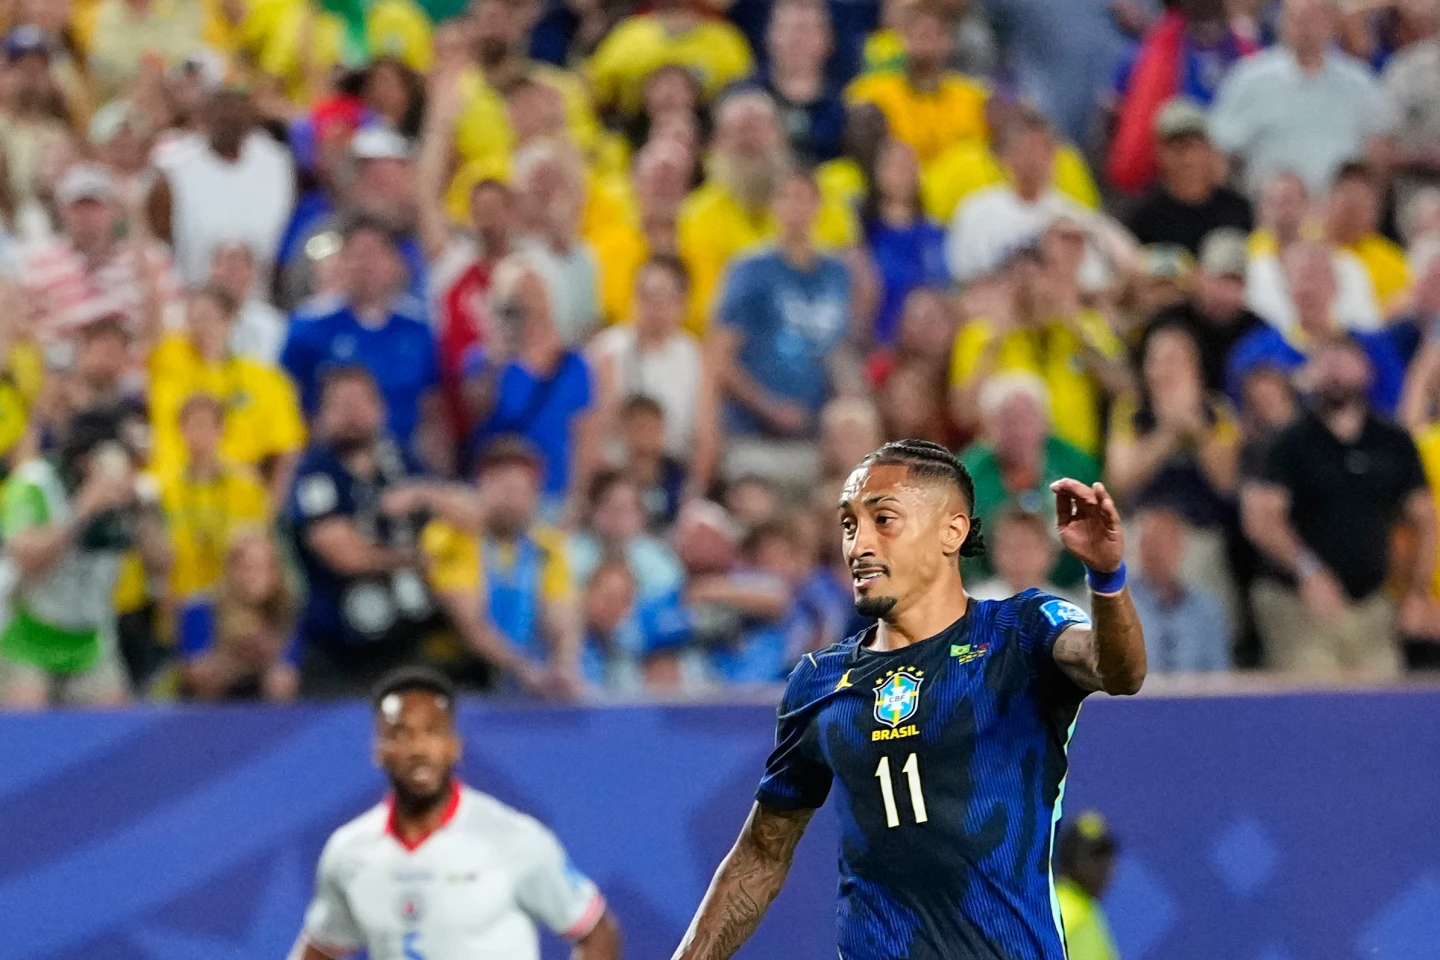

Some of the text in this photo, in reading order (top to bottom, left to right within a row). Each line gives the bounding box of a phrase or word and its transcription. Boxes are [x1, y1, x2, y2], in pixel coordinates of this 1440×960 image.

[888, 694, 906, 703] CBF
[871, 724, 920, 742] BRASIL
[874, 752, 929, 829] 11
